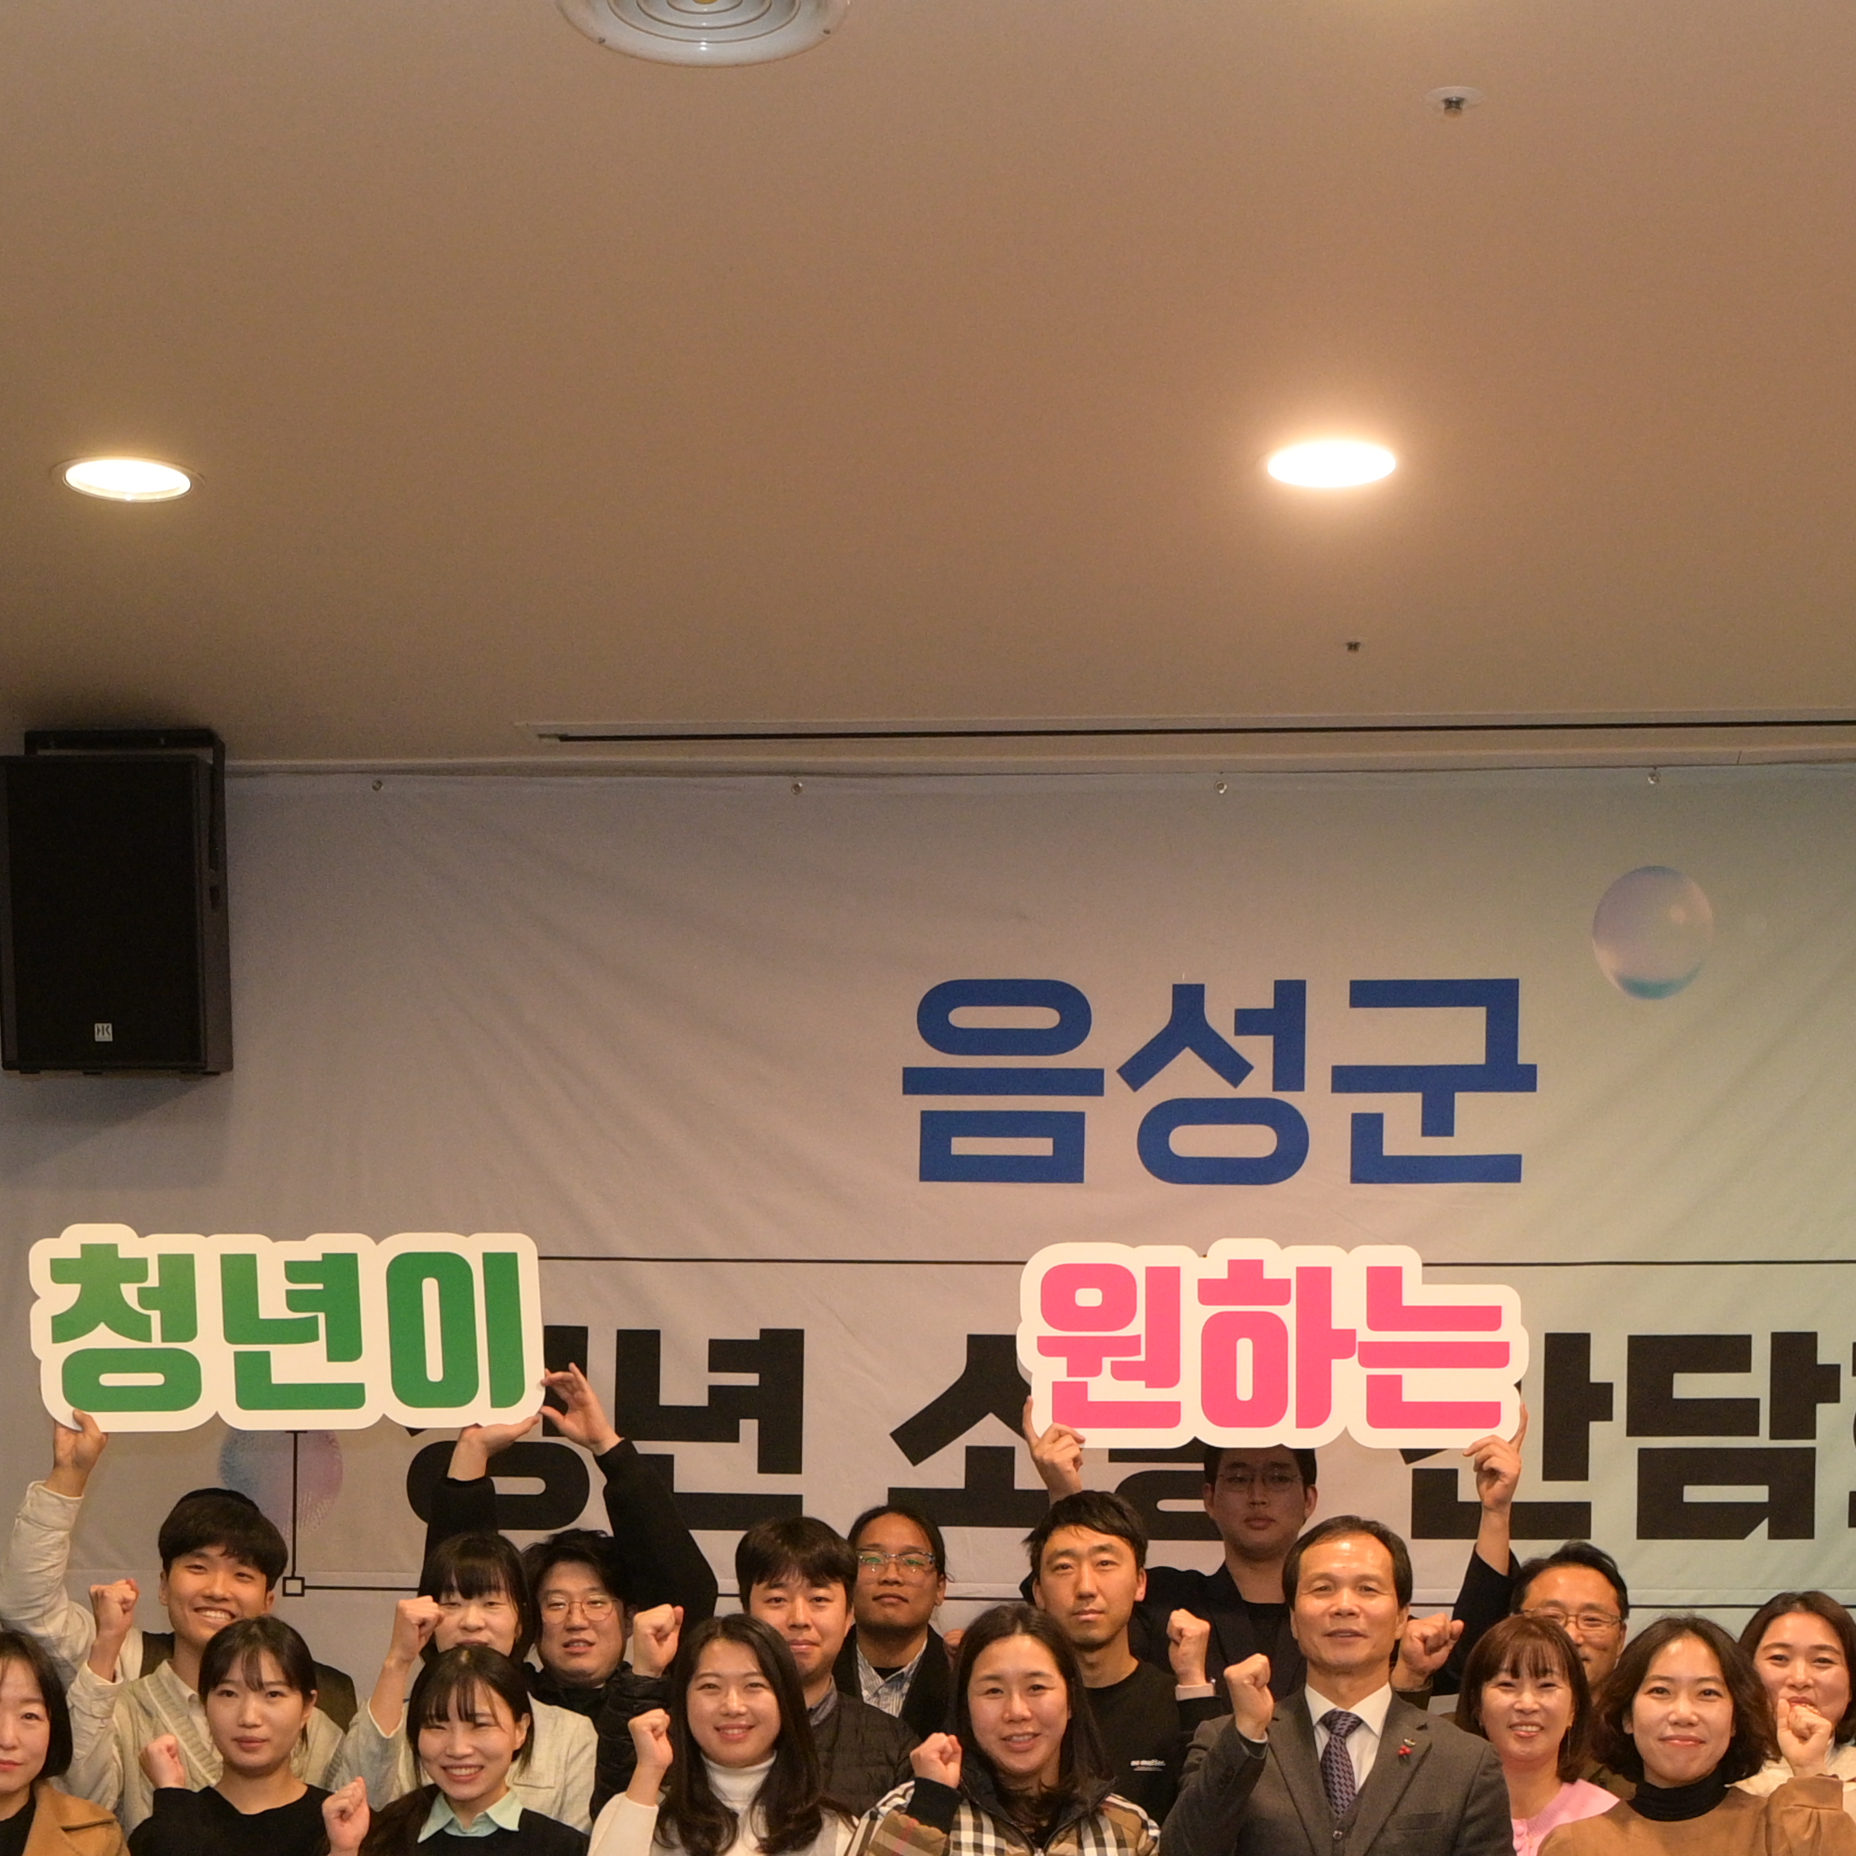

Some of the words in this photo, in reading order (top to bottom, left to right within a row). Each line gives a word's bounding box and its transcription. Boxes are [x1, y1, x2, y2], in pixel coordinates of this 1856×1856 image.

[903, 978, 1538, 1185] 음성군
[49, 1242, 527, 1412] 청년이
[1037, 1258, 1510, 1430] 원하는
